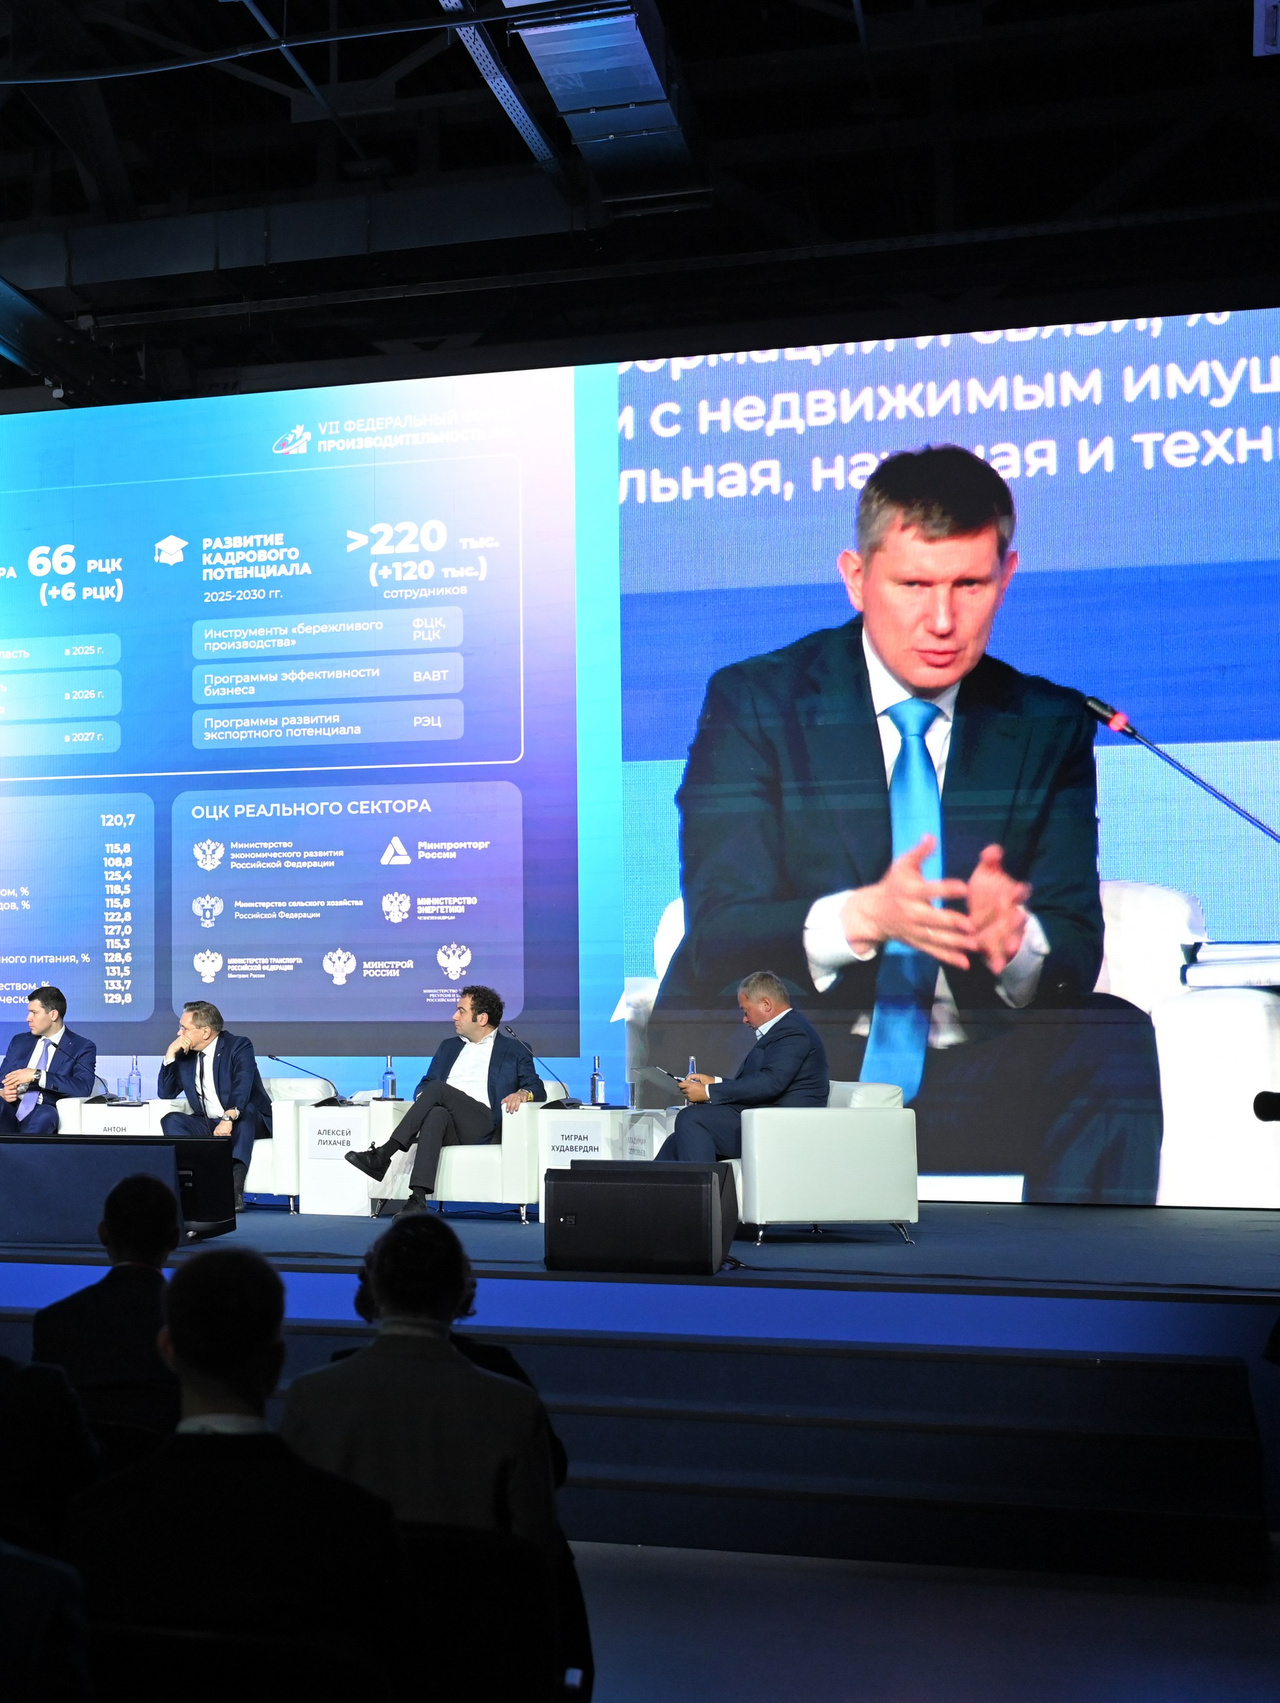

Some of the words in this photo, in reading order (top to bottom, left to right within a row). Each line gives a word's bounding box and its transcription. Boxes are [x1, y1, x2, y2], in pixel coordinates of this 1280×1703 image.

[699, 368, 1102, 437] недвижимым
[318, 420, 339, 435] VII
[811, 439, 1058, 492] наая
[1131, 425, 1280, 470] техн
[202, 532, 284, 550] РАЗВИТИЕ
[27, 543, 76, 576] 66
[87, 557, 122, 574] РЦК
[202, 547, 299, 566] КАДРОВОГО
[202, 562, 312, 581] ПОТЕНЦИАЛА
[82, 578, 123, 602] РЦК)
[204, 589, 266, 602] 2025-2030
[383, 585, 467, 600] сотрудников
[204, 626, 288, 639] Инструменты
[413, 629, 440, 642] РЦК
[72, 645, 95, 655] 2025
[204, 638, 296, 652] производства»
[204, 673, 278, 687] Программы
[281, 667, 380, 682] эффективности
[413, 669, 448, 682] ВАВТ
[72, 689, 95, 699] 2026
[204, 683, 255, 696] бизнеса
[204, 717, 278, 730] Программы
[281, 714, 339, 727] развития
[413, 715, 441, 728] РЭЦ
[72, 731, 95, 742] 2027
[204, 729, 282, 741] экспортного
[286, 725, 361, 737] потенциала
[191, 804, 229, 820] ОЦК
[234, 801, 343, 817] РЕАЛЬНОГО
[347, 798, 431, 814] СЕКТОРА
[100, 813, 135, 828] 120,7
[105, 842, 130, 855] 115,8
[230, 841, 293, 849] Министерство
[417, 840, 490, 853] Минпромторг
[230, 851, 301, 860] экономического
[303, 850, 344, 859] развития
[418, 850, 456, 859] России
[103, 856, 132, 868] 108,8
[230, 860, 282, 869] Российской
[283, 860, 334, 868] Федерации
[103, 870, 132, 882] 125,4
[104, 883, 130, 896] 118,5
[104, 897, 130, 909] 115,8
[234, 900, 287, 909] Министерство
[416, 896, 477, 905] МИНИСТЕРСТВО
[103, 911, 131, 923] 122,8
[234, 911, 276, 919] Российской
[278, 910, 320, 919] Федерации
[103, 924, 132, 936] 127,0
[105, 938, 130, 950] 115,3
[29, 954, 78, 964] питания,
[103, 952, 132, 964] 128,6
[362, 959, 413, 970] МИНСТРОЙ
[105, 965, 130, 978] 131,5
[362, 969, 399, 977] РОССИИ
[103, 979, 131, 992] 133,7
[103, 993, 132, 1005] 129,8
[317, 1128, 351, 1136] АЛЕКСЕЙ
[551, 1145, 599, 1153] ХУДАВЕРДЯН
